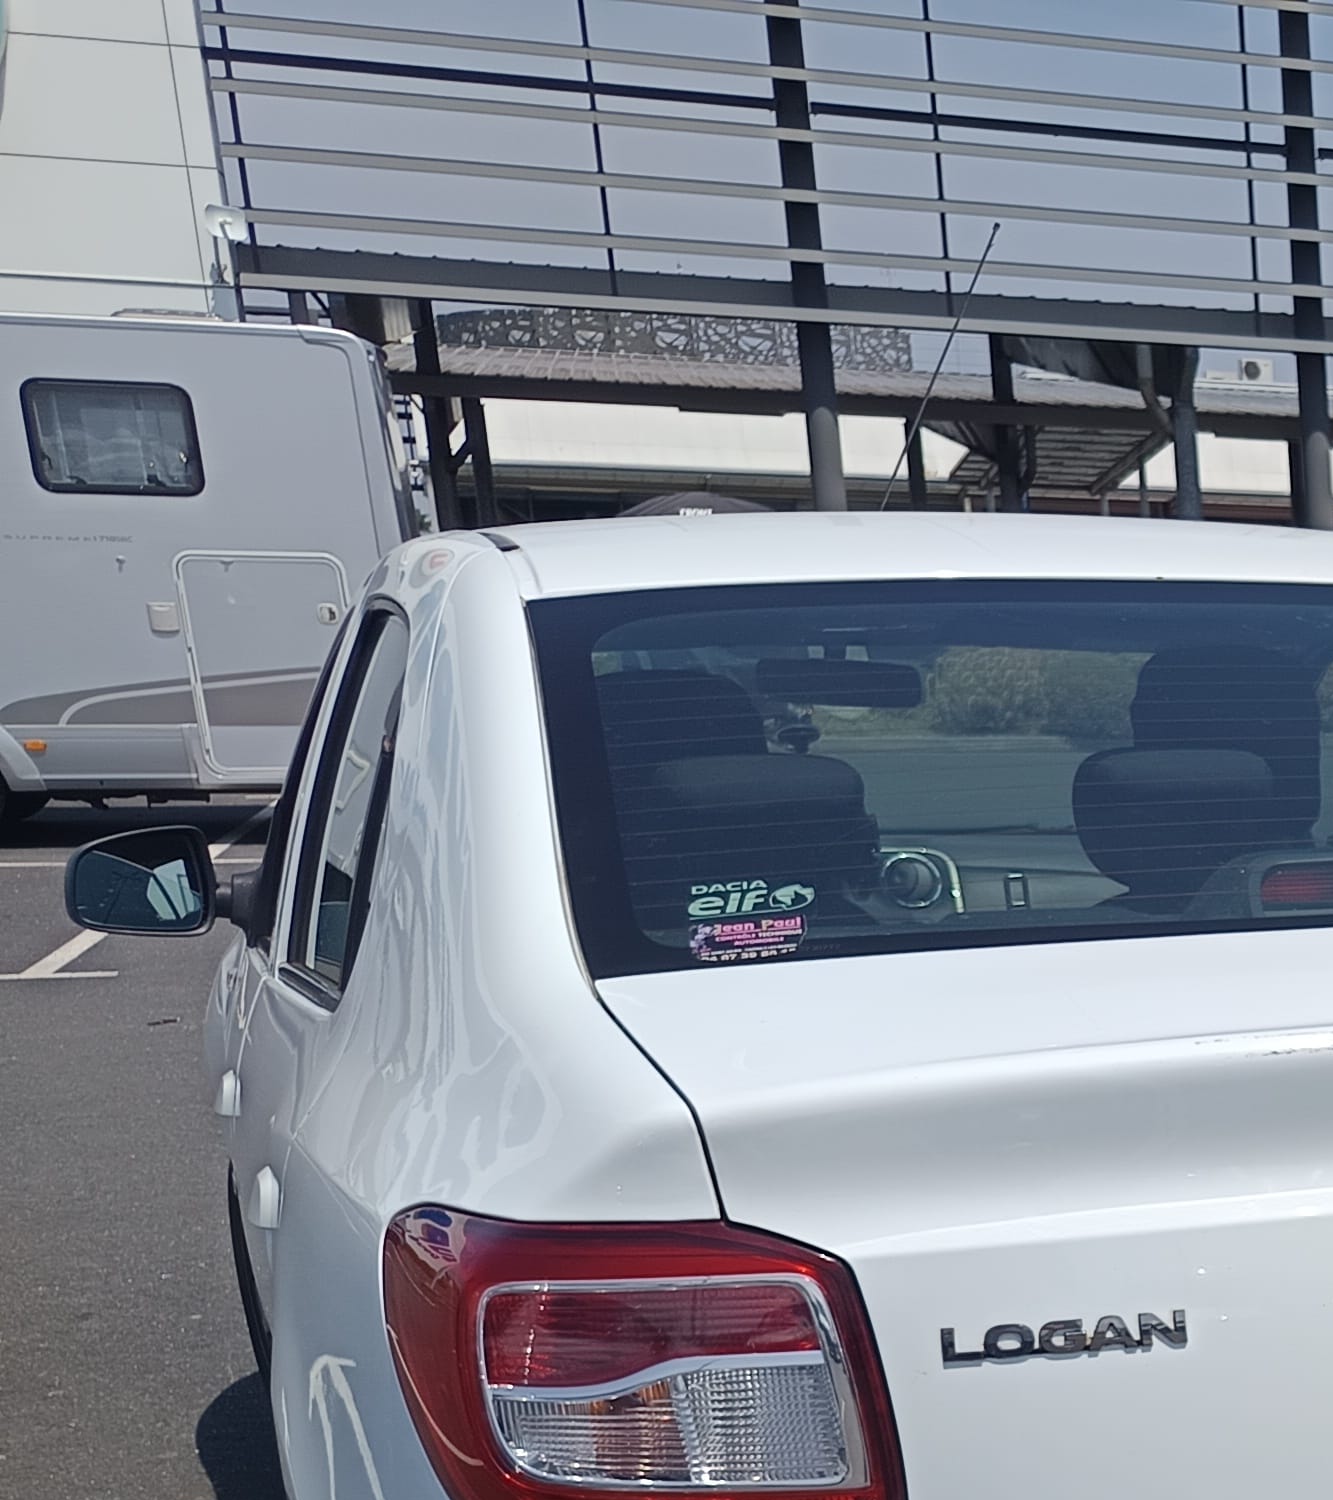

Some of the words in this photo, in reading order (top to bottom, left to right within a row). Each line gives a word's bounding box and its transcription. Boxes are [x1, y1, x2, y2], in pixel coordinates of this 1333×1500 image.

[691, 880, 768, 895] DACIA
[688, 889, 768, 916] elf
[714, 922, 755, 935] Jean
[761, 916, 801, 931] Paul
[940, 1309, 1188, 1369] LOGAN
